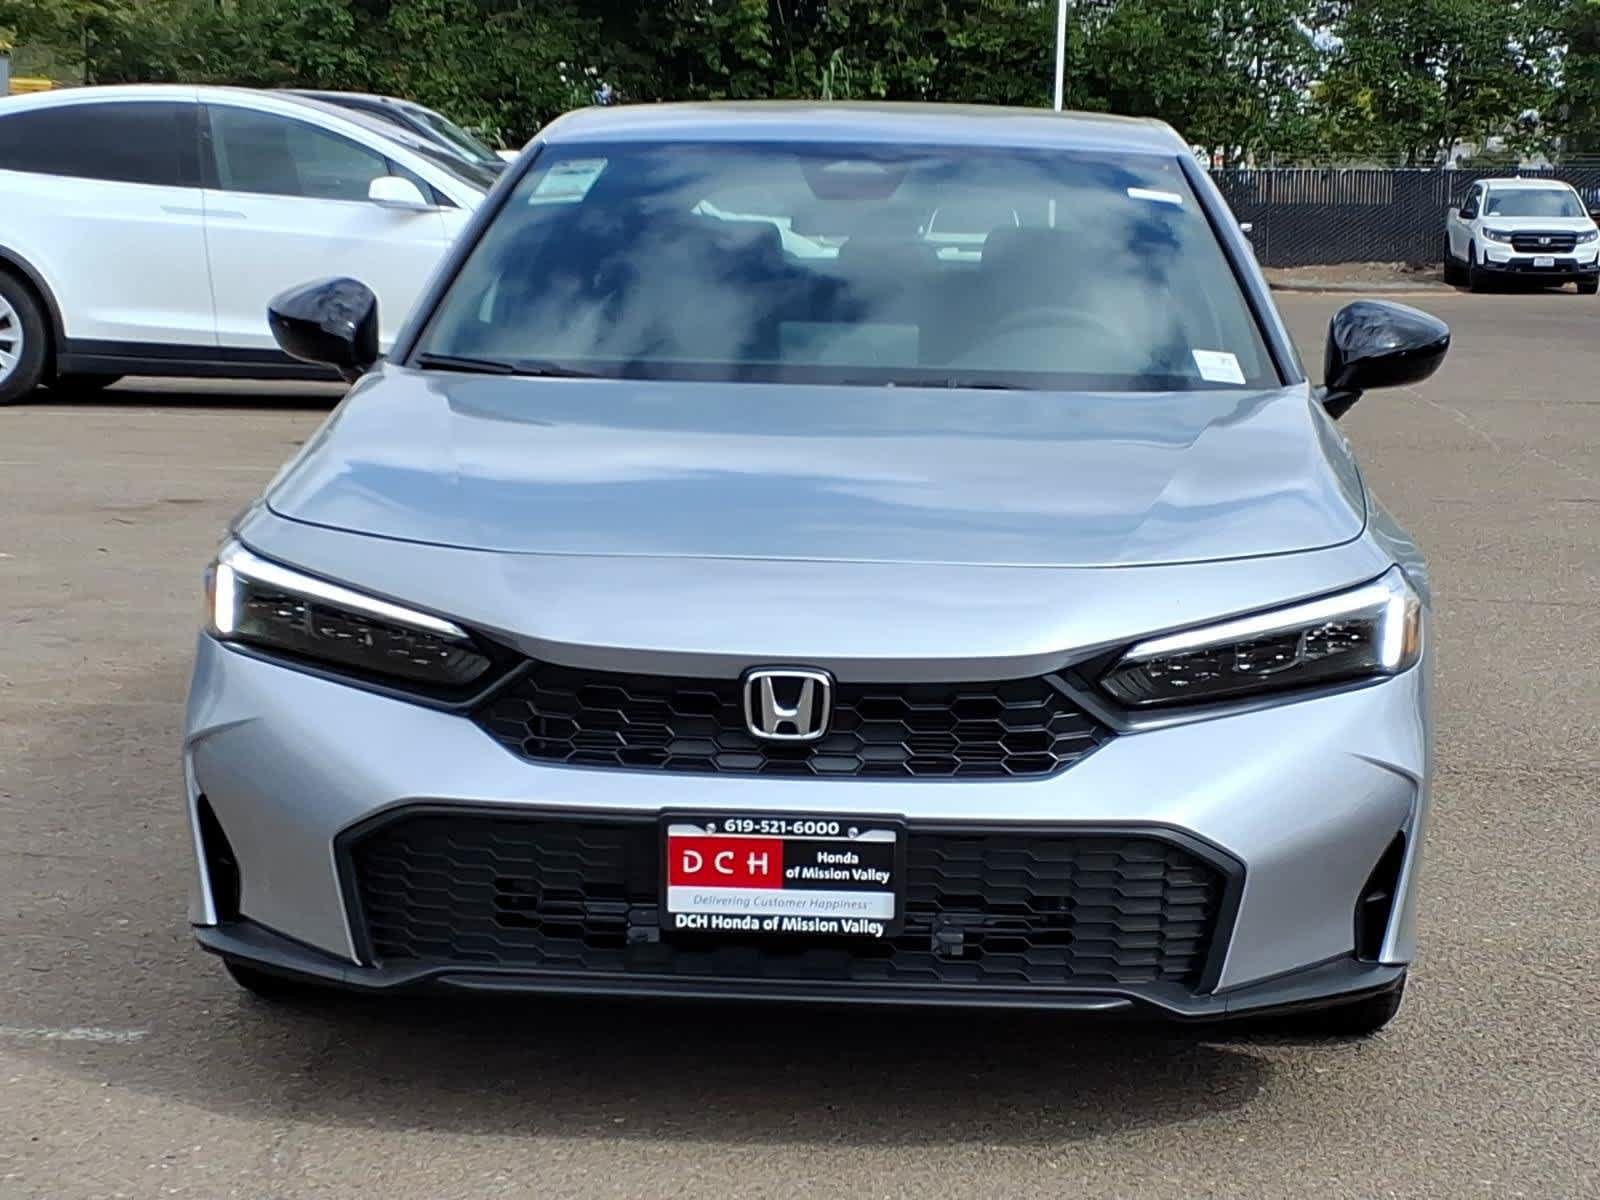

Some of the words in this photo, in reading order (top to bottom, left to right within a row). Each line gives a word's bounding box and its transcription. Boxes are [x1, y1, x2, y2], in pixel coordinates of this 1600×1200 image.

[725, 819, 840, 835] 619-521-6000
[817, 851, 859, 865] Honda
[785, 866, 800, 878] of
[802, 867, 850, 880] Mission
[851, 868, 890, 884] Valley
[693, 894, 750, 908] Delivering
[753, 896, 807, 908] Customer
[675, 914, 708, 929] DCH
[711, 914, 760, 930] Honda
[763, 916, 779, 931] of
[781, 917, 838, 932] Mission
[841, 919, 884, 938] Valley
